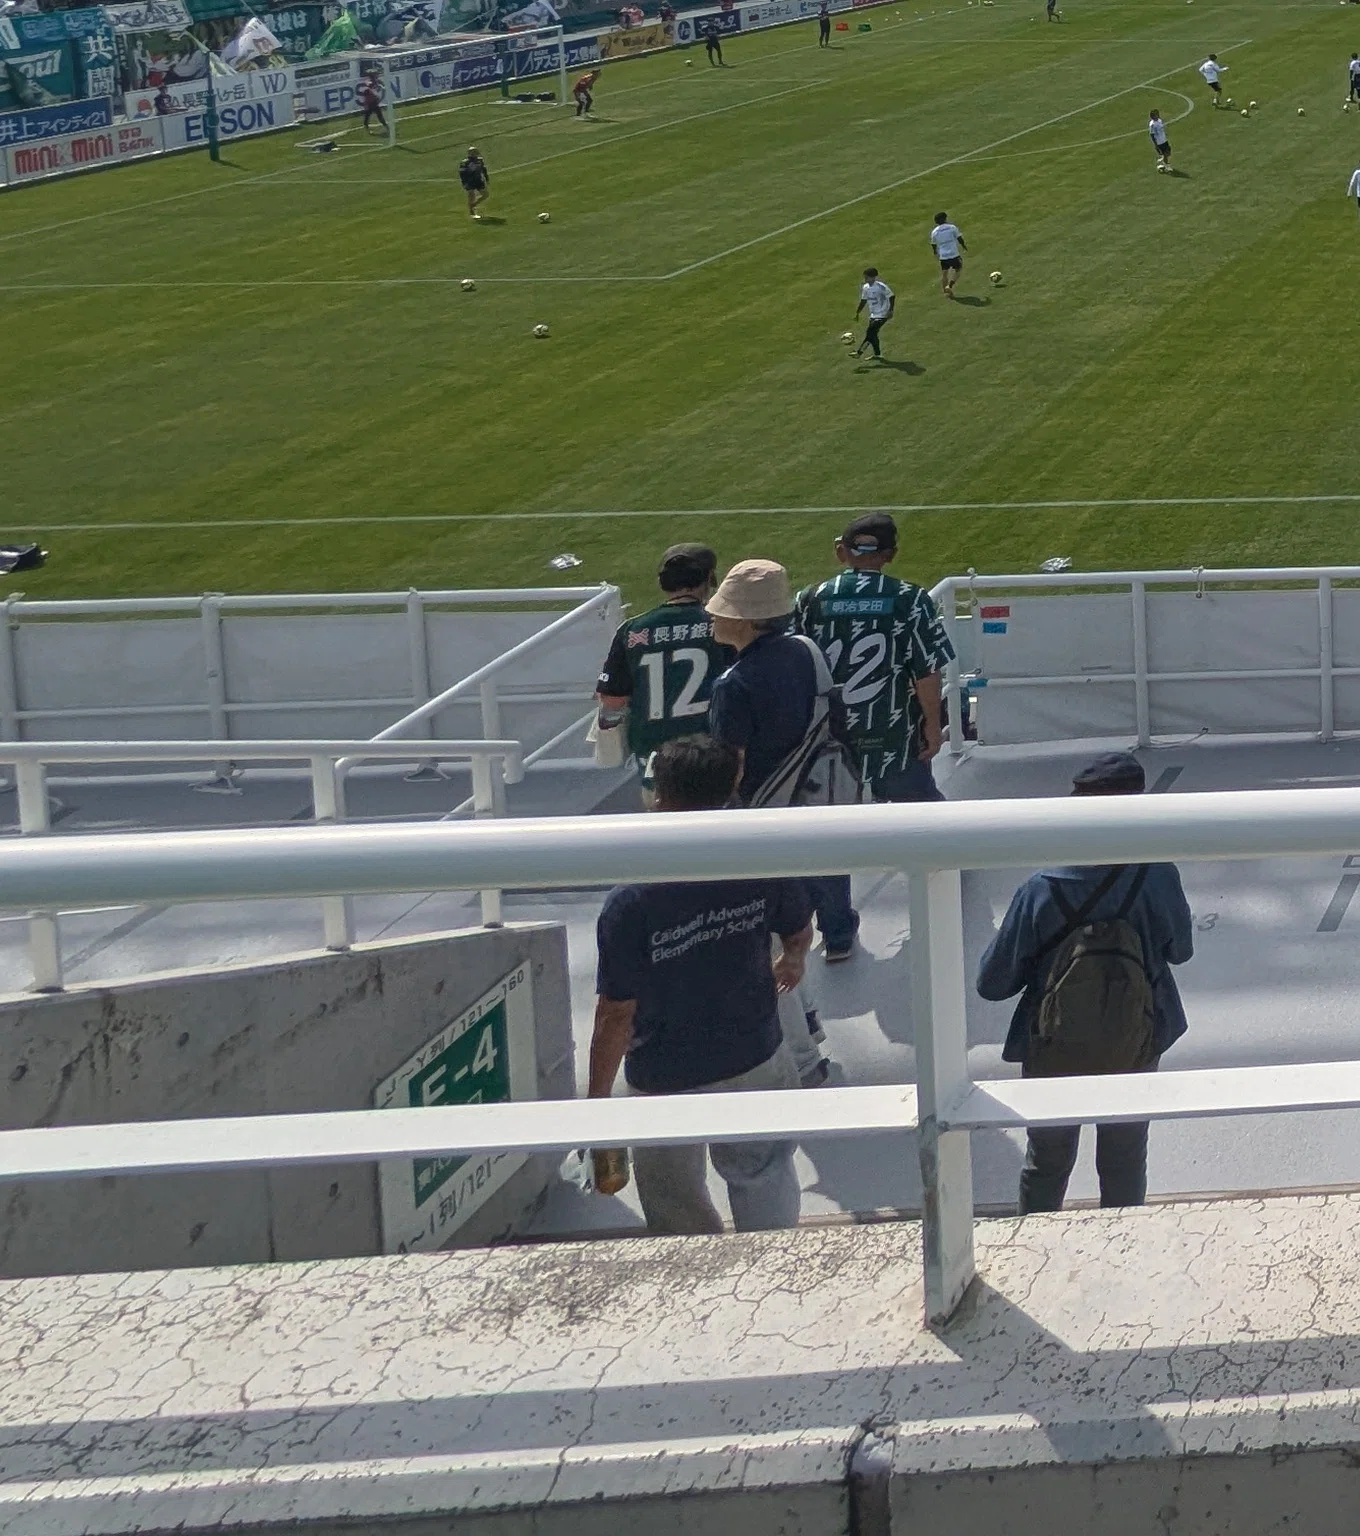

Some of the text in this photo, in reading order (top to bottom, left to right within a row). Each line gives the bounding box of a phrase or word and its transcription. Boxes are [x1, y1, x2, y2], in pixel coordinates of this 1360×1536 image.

[831, 599, 884, 614] 明治安田
[637, 647, 710, 721] 12
[651, 913, 704, 946] Caldwell
[651, 926, 725, 963] Elementary
